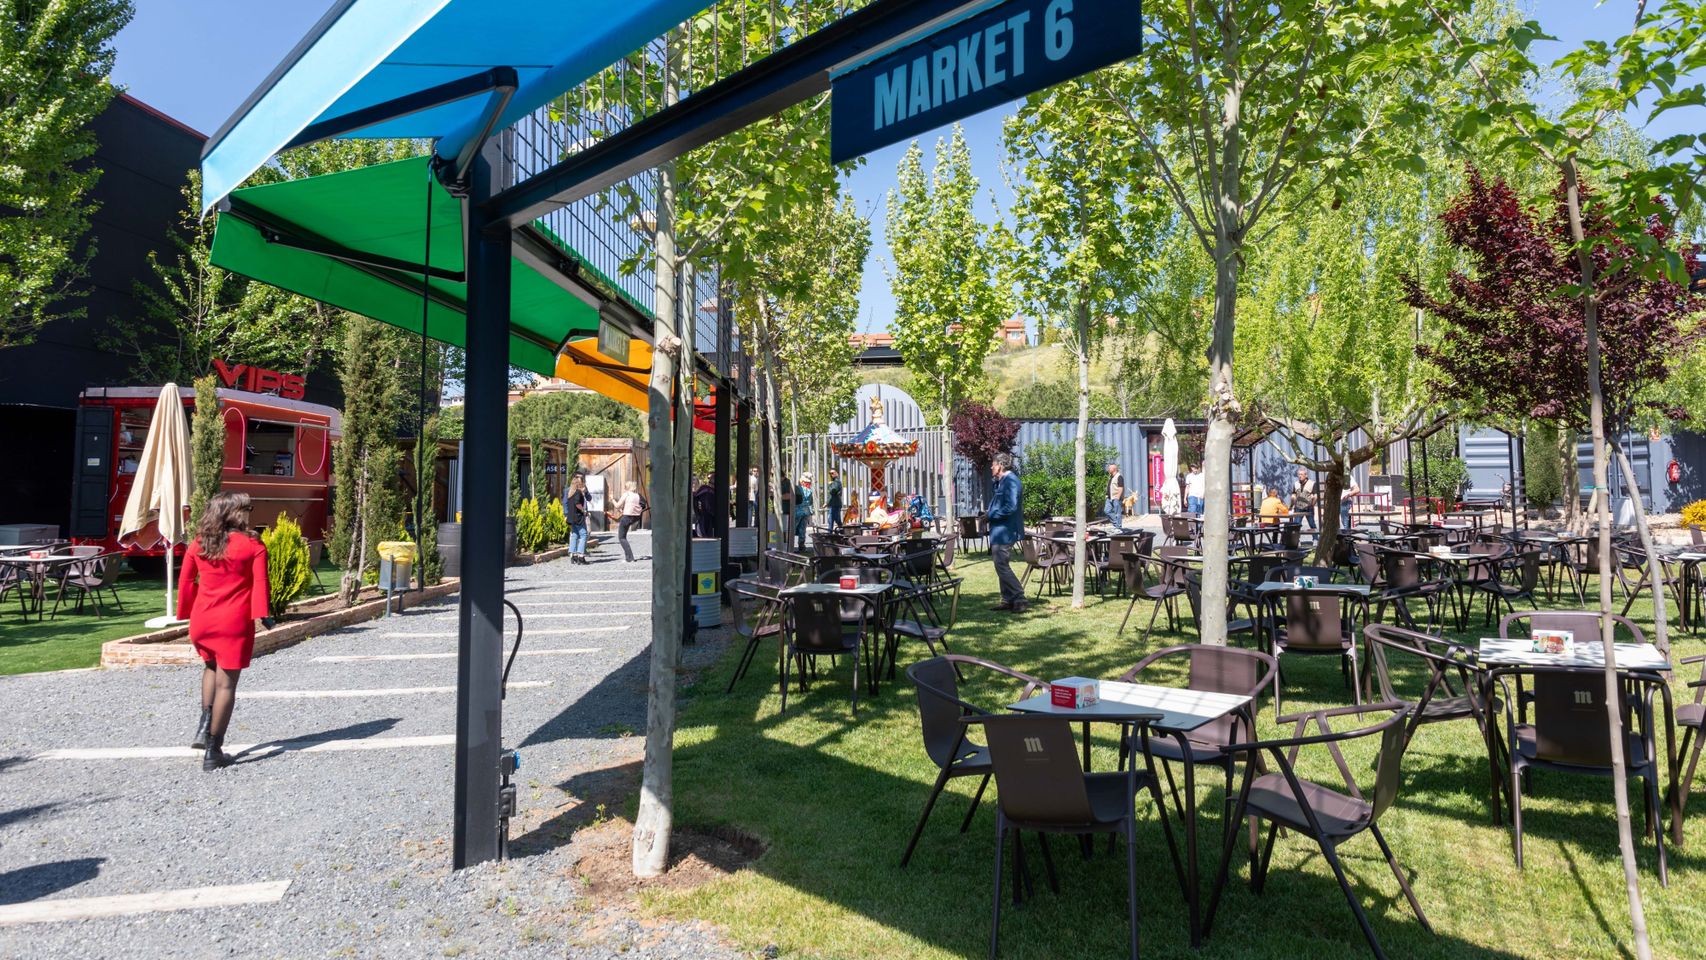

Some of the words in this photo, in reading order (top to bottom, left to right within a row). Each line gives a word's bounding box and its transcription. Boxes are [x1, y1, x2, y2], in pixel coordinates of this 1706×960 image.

[874, 9, 1031, 131] MARKET
[1044, 0, 1074, 61] 6
[212, 357, 305, 400] VIPS
